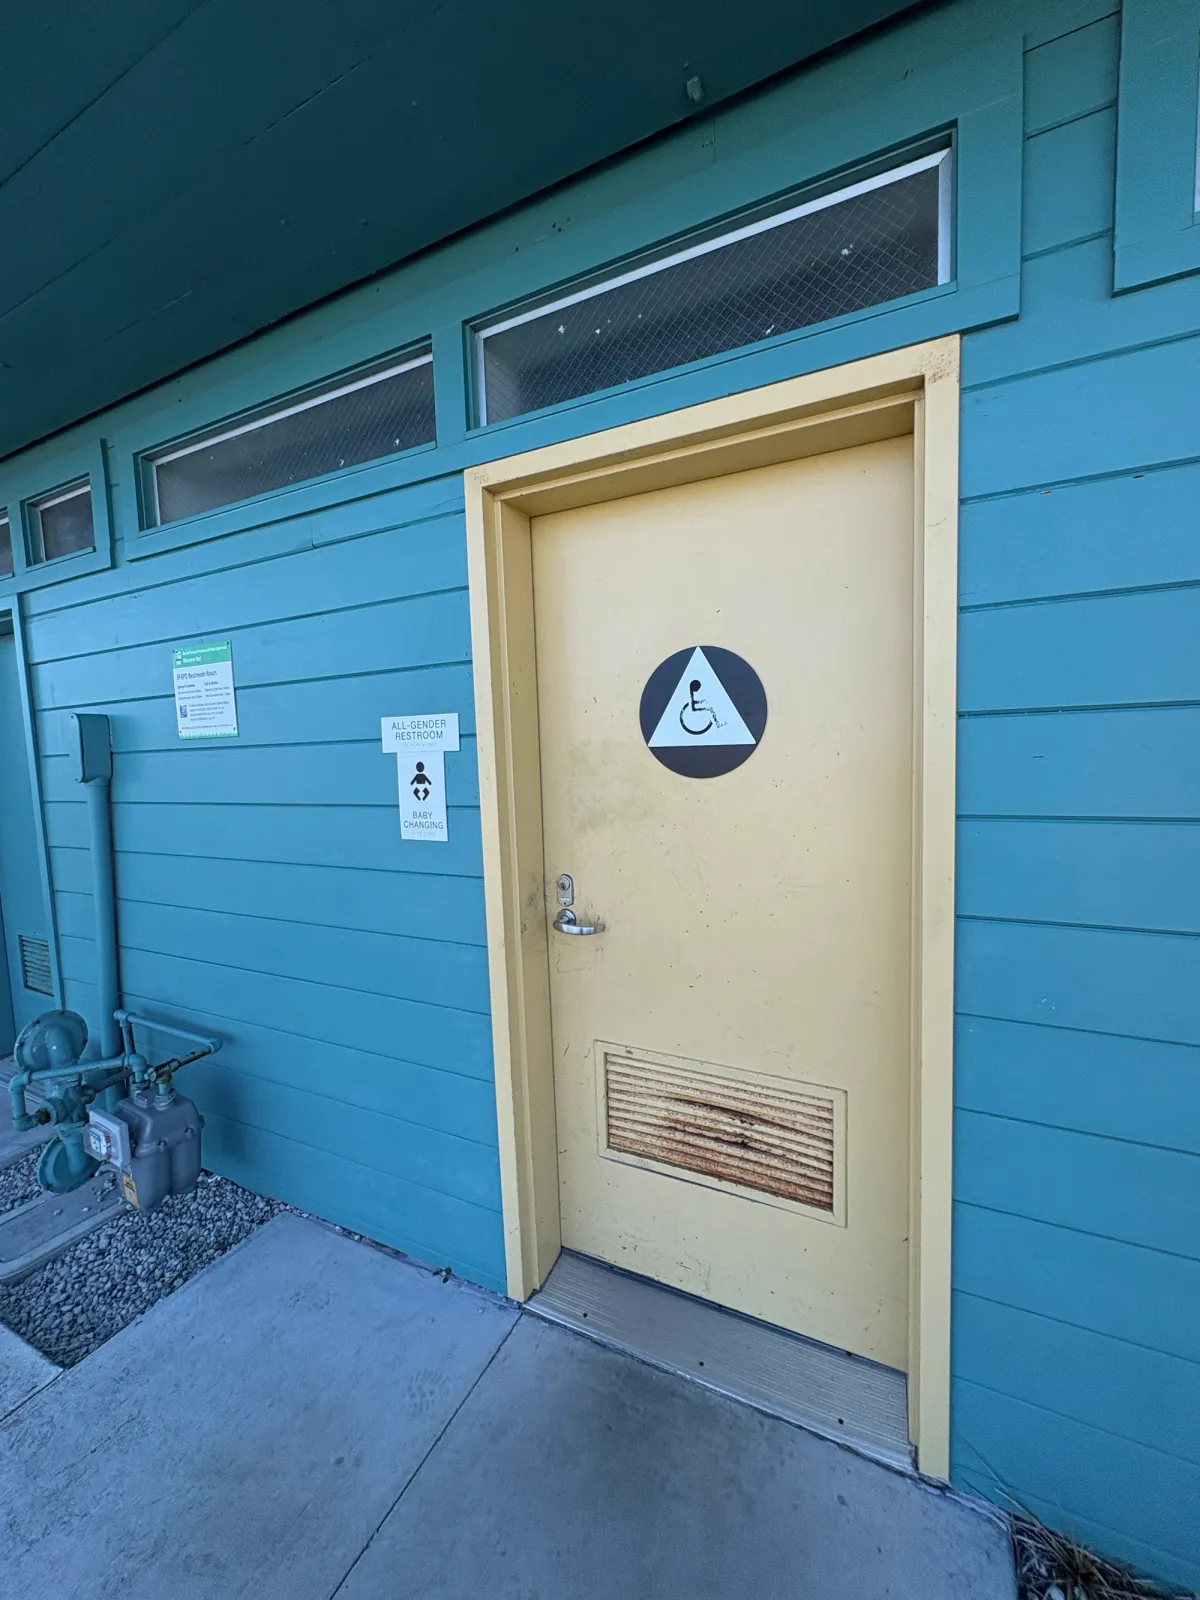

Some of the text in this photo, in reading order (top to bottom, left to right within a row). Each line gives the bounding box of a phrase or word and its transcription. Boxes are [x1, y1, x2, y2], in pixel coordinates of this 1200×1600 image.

[392, 719, 447, 730] ALL-GENDER
[395, 730, 444, 740] RESTROOM
[412, 811, 433, 819] BABY
[403, 820, 444, 830] CHANGING
